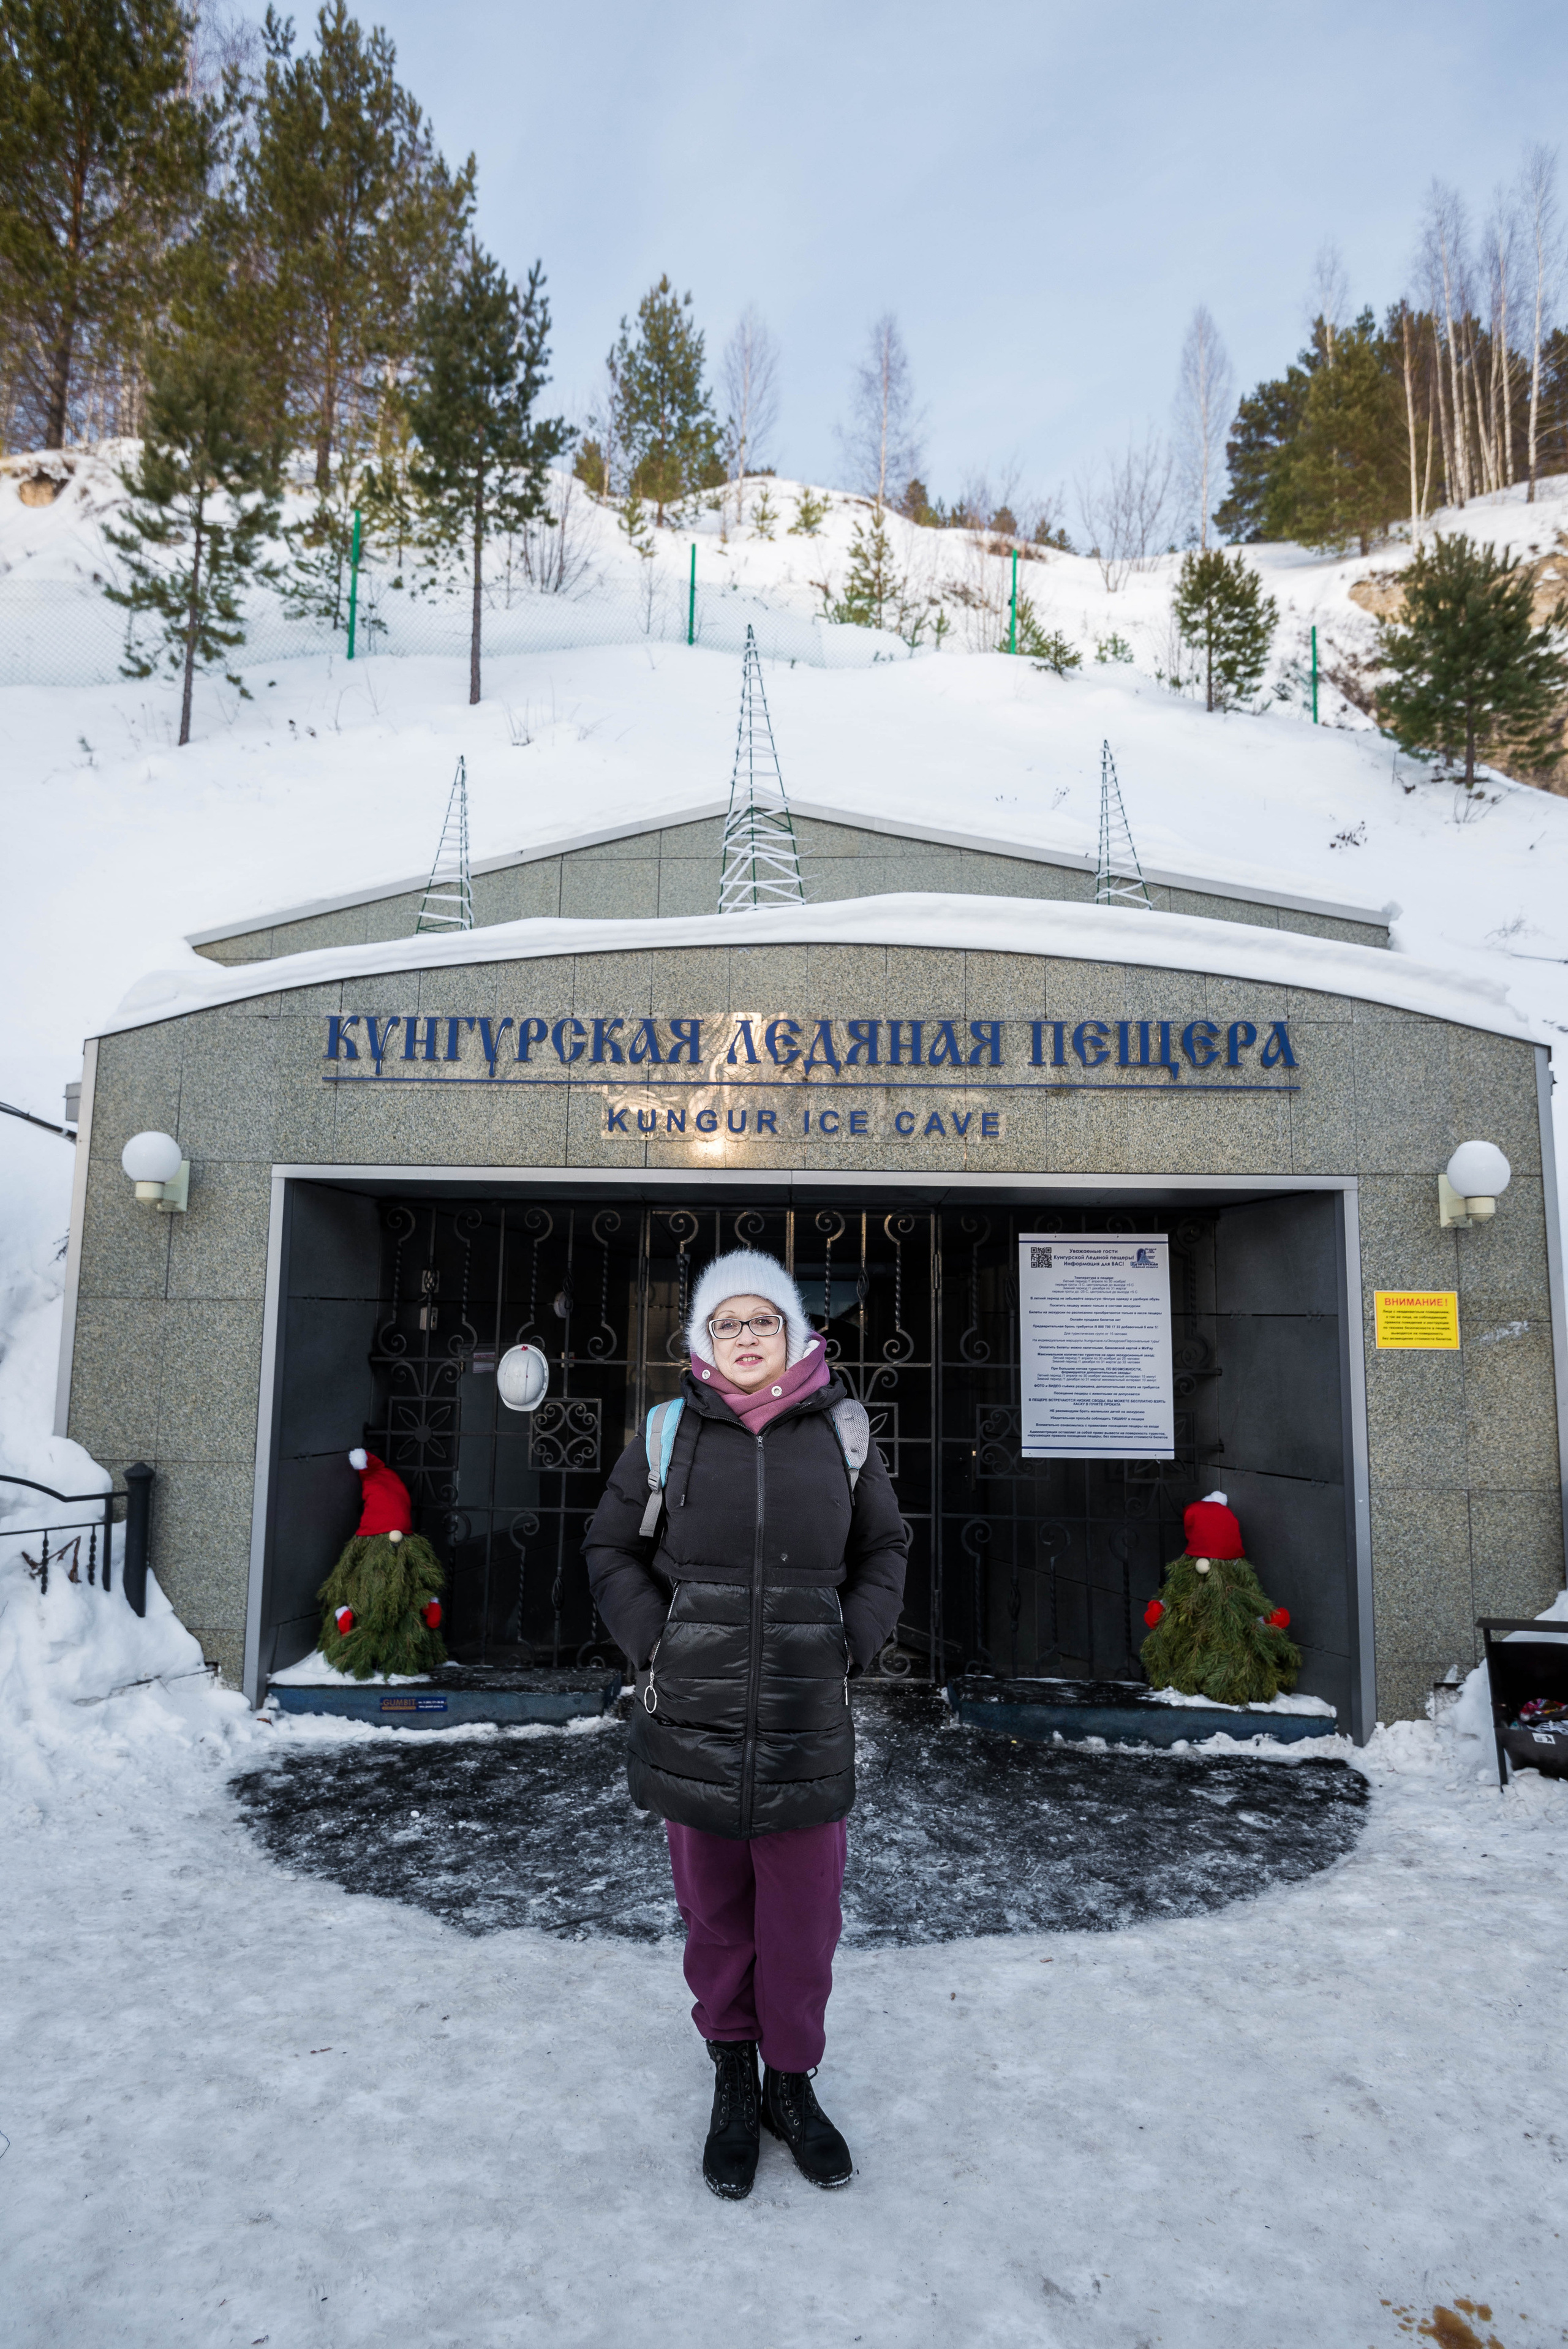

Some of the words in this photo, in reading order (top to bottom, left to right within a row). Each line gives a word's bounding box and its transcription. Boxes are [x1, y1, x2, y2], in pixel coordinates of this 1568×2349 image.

[323, 1015, 704, 1077] КУНГУРСКАЯ
[727, 1019, 1005, 1077] ЛЕДЯНАЯ
[1028, 1020, 1300, 1080] ПЕЩЕРА
[608, 1109, 778, 1134] KUNGUR
[803, 1110, 869, 1134] ICE
[894, 1111, 1000, 1136] CAVE
